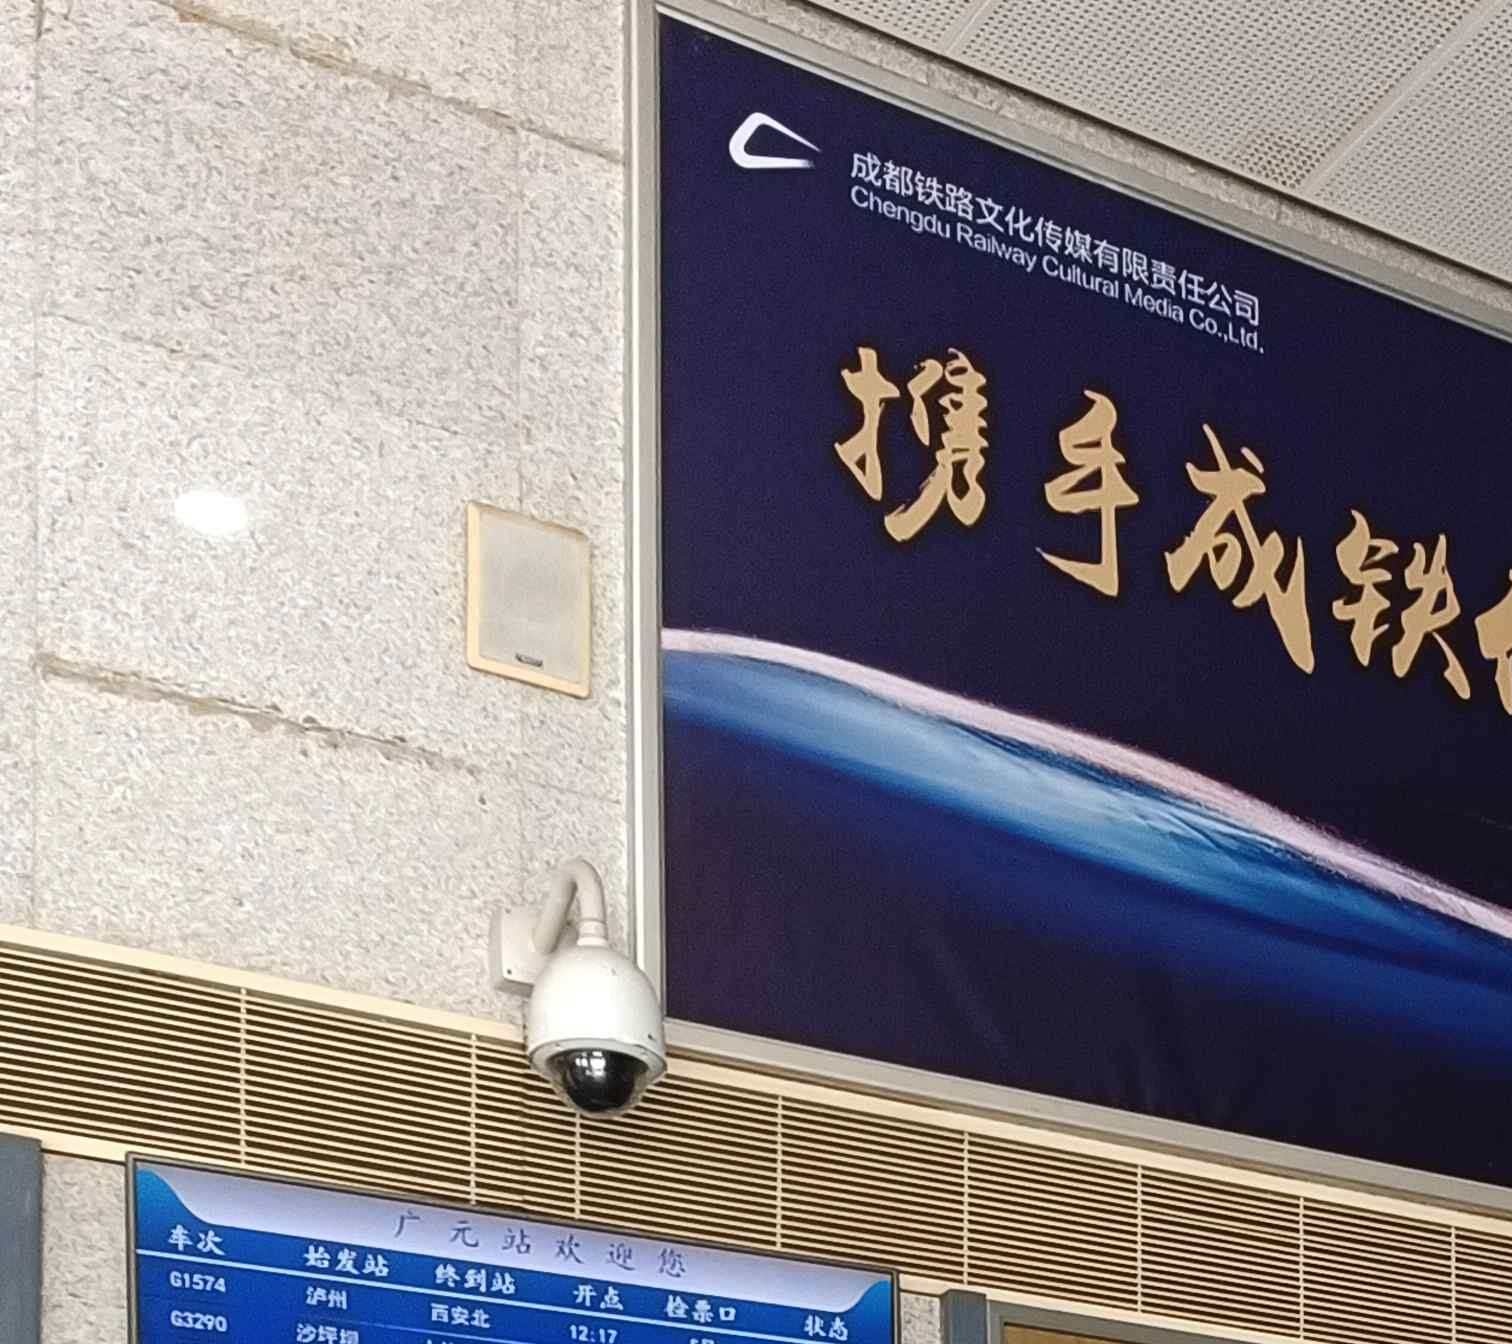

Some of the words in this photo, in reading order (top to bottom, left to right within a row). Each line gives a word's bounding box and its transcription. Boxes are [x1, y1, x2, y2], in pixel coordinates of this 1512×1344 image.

[850, 151, 1260, 326] 成都铁路文化传媒有限责任公司
[850, 184, 951, 240] Chengdu
[956, 222, 1038, 273] Railway
[1042, 254, 1120, 299] Cultural
[1123, 283, 1184, 324] Media
[1189, 309, 1265, 354] Co.,Ltd.
[168, 1224, 226, 1256] 车次
[303, 1244, 390, 1278] 始发站
[435, 1263, 515, 1295] 终到站
[572, 1285, 624, 1312] 开点
[664, 1295, 738, 1323] 检票口
[804, 1315, 850, 1342] 状态
[169, 1269, 227, 1293] G1574
[305, 1286, 349, 1310] 泸州
[430, 1302, 491, 1329] 西安北
[170, 1309, 228, 1333] G3290
